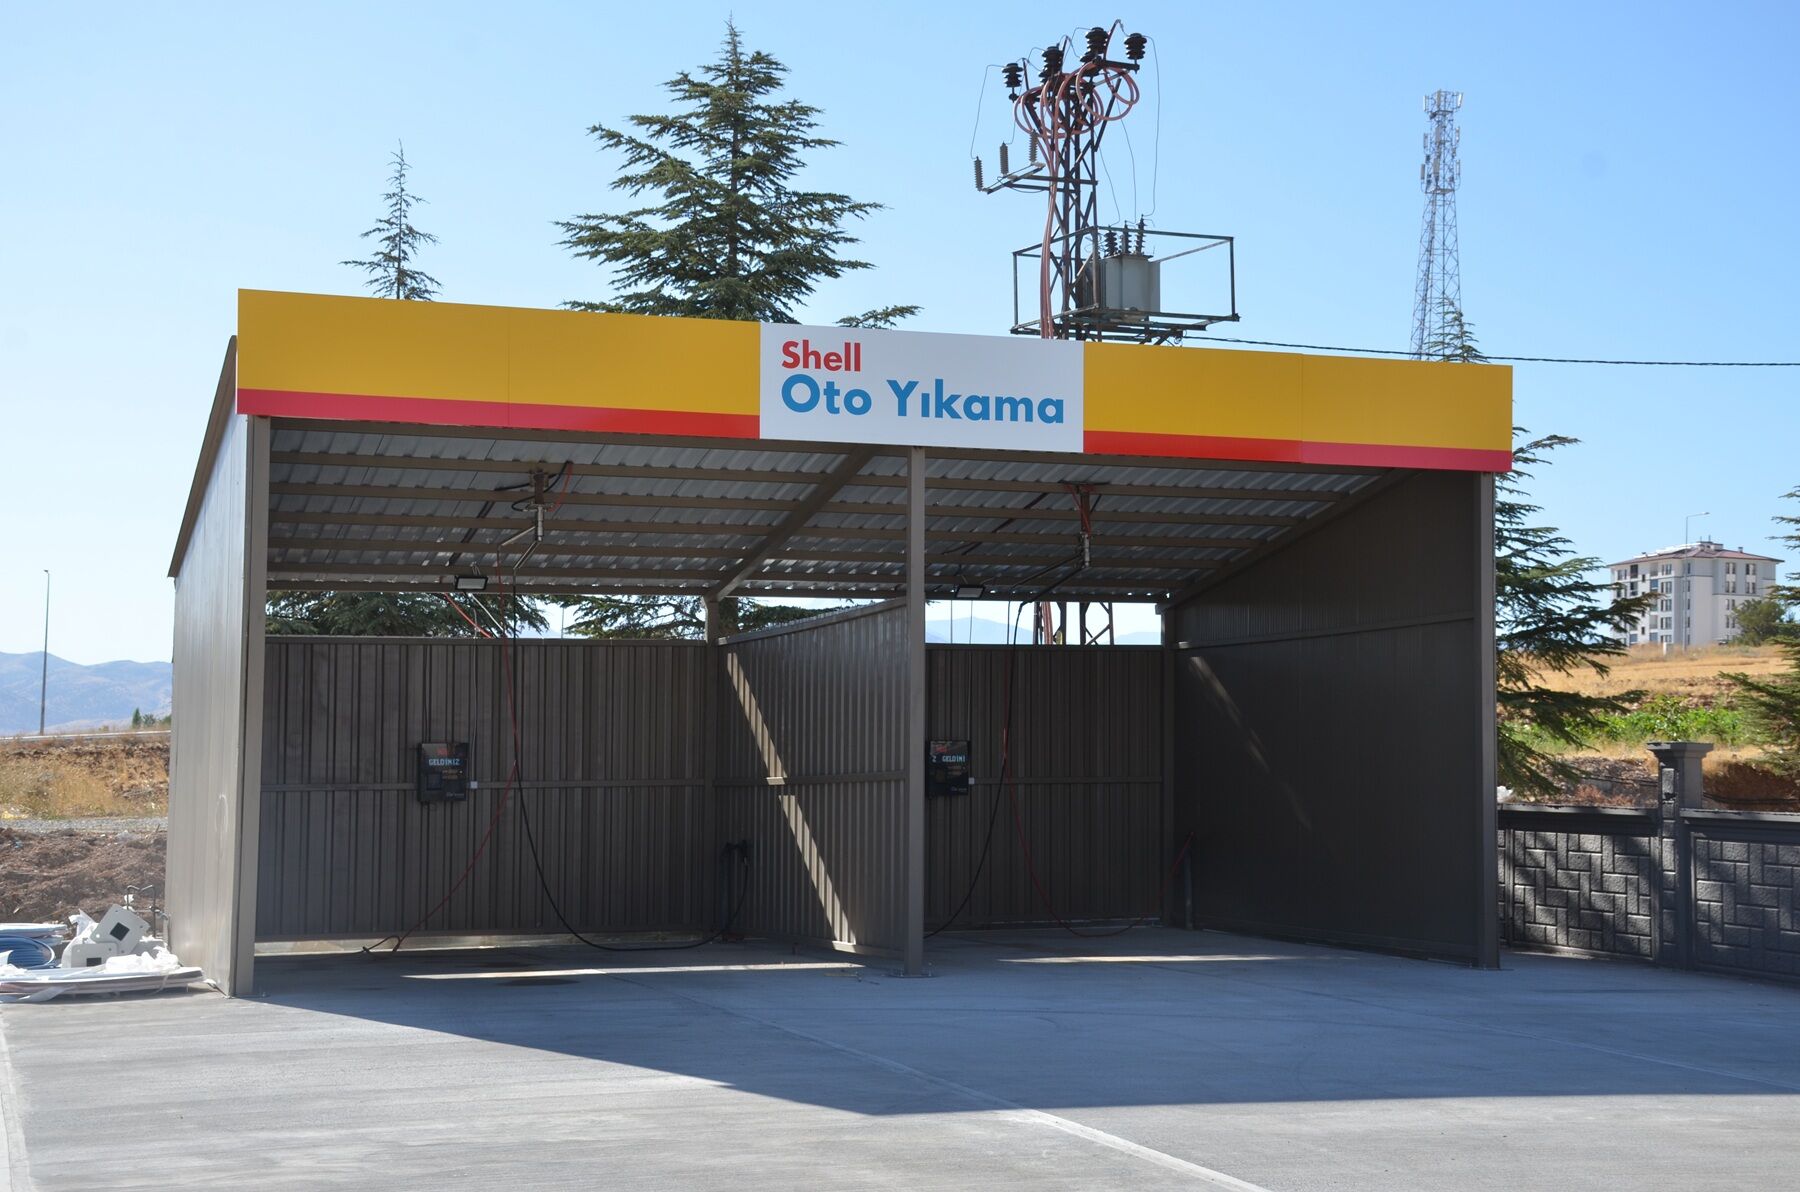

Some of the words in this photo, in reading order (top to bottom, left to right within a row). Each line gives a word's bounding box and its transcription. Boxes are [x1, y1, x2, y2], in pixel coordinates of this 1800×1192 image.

[781, 339, 861, 372] Shell
[781, 373, 872, 416] Oto
[886, 378, 1064, 424] Yıkama
